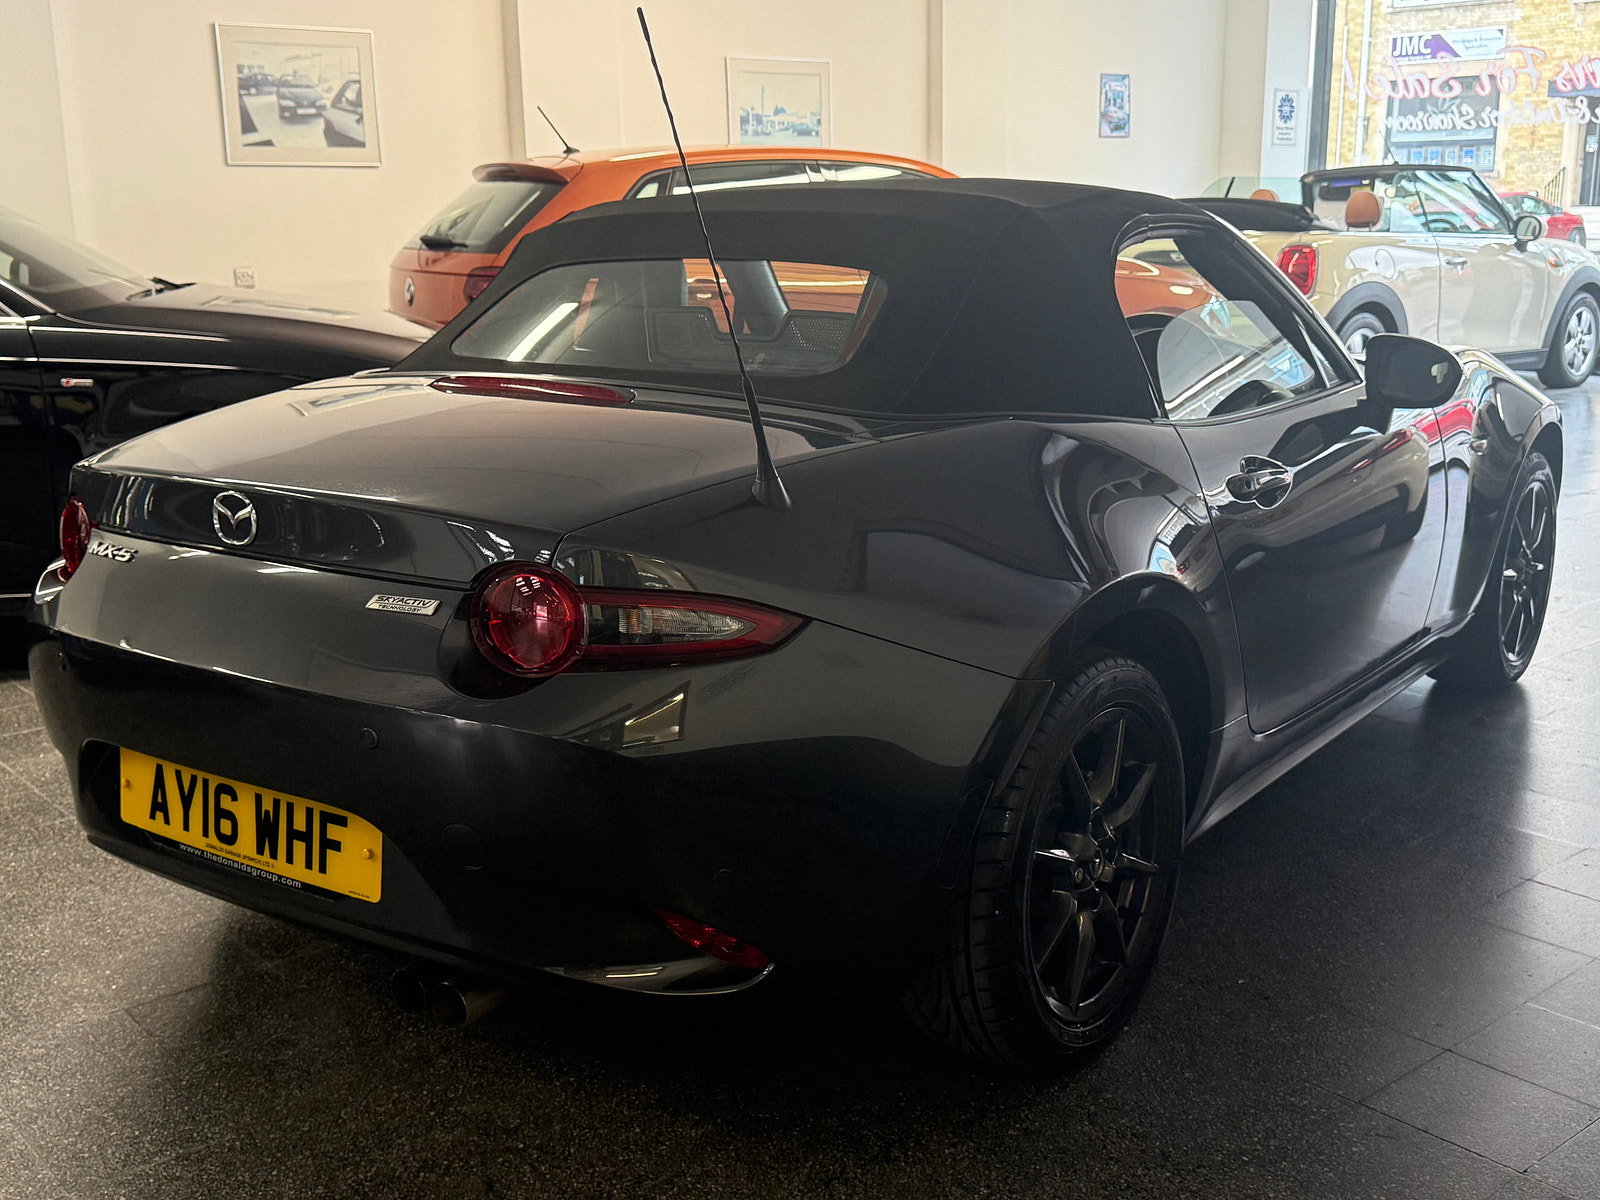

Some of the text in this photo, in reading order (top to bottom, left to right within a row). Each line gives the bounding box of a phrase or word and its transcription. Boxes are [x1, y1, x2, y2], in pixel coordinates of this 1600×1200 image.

[1393, 35, 1432, 57] JMC
[88, 541, 138, 562] MX-5
[375, 596, 432, 606] SKYACTIV
[378, 604, 421, 613] TECHNOLOGY
[149, 763, 349, 875] AY16 WHF
[179, 843, 302, 889] www.thedonaldsgroup.com
